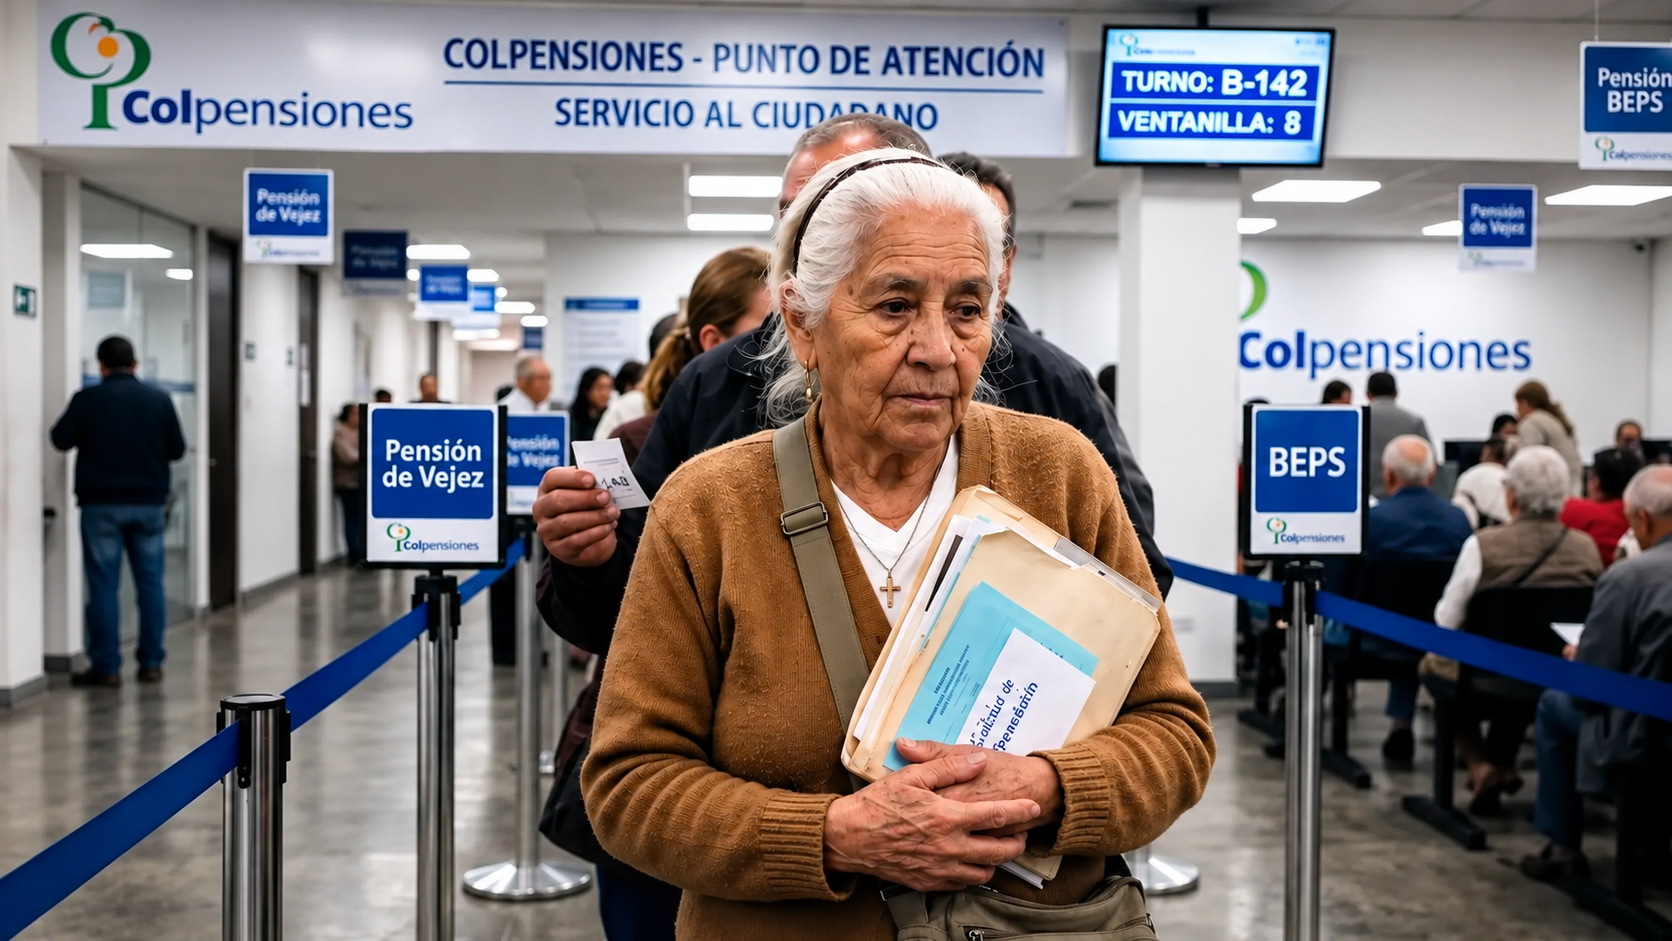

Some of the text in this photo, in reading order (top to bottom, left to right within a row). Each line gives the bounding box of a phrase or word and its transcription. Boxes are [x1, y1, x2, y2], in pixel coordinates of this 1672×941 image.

[443, 37, 684, 73] COLPENSIONES
[713, 42, 821, 75] PUNTO
[830, 44, 871, 76] DE
[881, 39, 1045, 78] ATENCIÓN
[1121, 68, 1307, 97] TURNO: B-142
[1598, 67, 1672, 88] Pensión
[122, 89, 413, 134] Colpensiones
[555, 97, 694, 128] SERVICIO
[704, 100, 742, 128] AL
[1607, 90, 1664, 113] BEPS
[1118, 110, 1301, 135] VENTANILLA: 8
[257, 188, 320, 205] Pensión
[255, 205, 321, 226] de Vejez
[1239, 330, 1531, 378] Colpensiones
[386, 438, 482, 462] Pensión
[1269, 446, 1346, 478] BEPS
[382, 464, 485, 494] de Vejez
[403, 540, 480, 553] Colpensiones
[1280, 533, 1345, 545] Colpensiones
